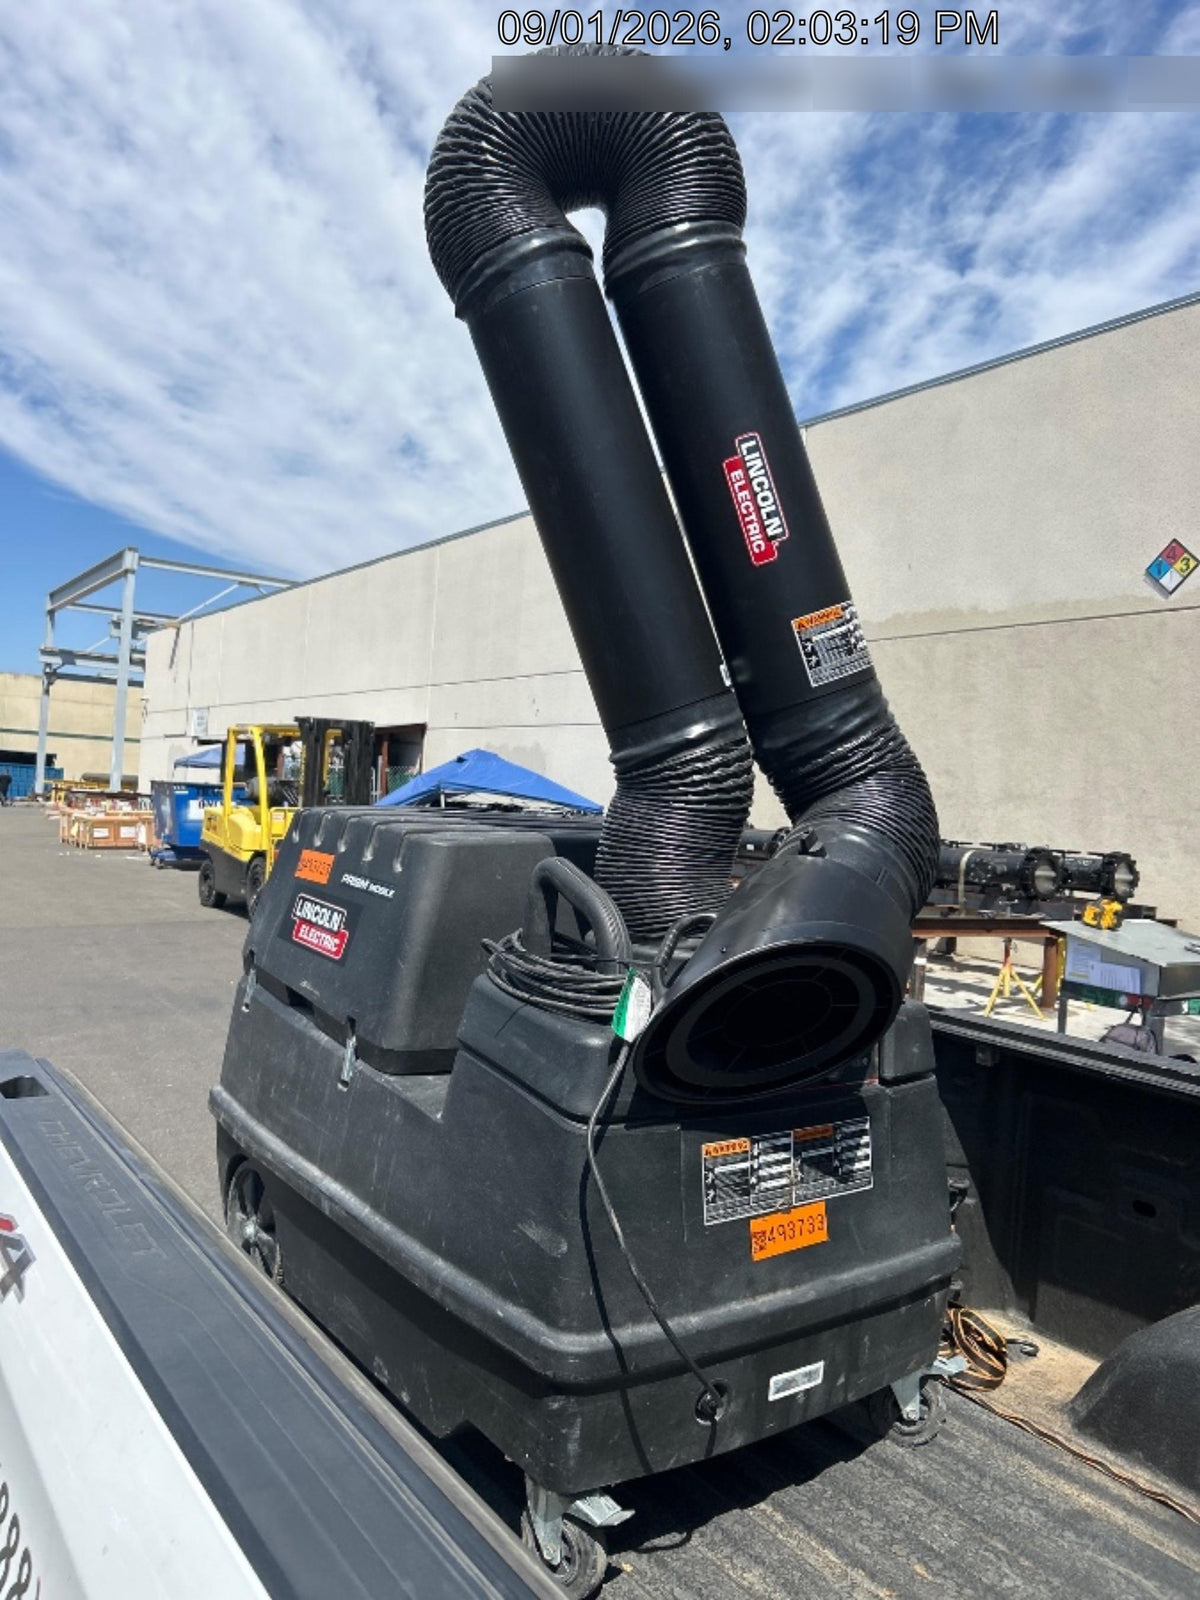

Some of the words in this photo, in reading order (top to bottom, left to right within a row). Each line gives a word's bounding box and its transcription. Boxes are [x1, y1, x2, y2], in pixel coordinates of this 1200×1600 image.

[740, 440, 783, 541] LINCOLN
[730, 468, 766, 554] ELECTRIC
[1179, 556, 1191, 574] 3
[296, 898, 342, 932] LINCOLN
[298, 924, 340, 952] ELECTRIC
[38, 1120, 168, 1258] CHEVROLET
[767, 1213, 825, 1244] 493733
